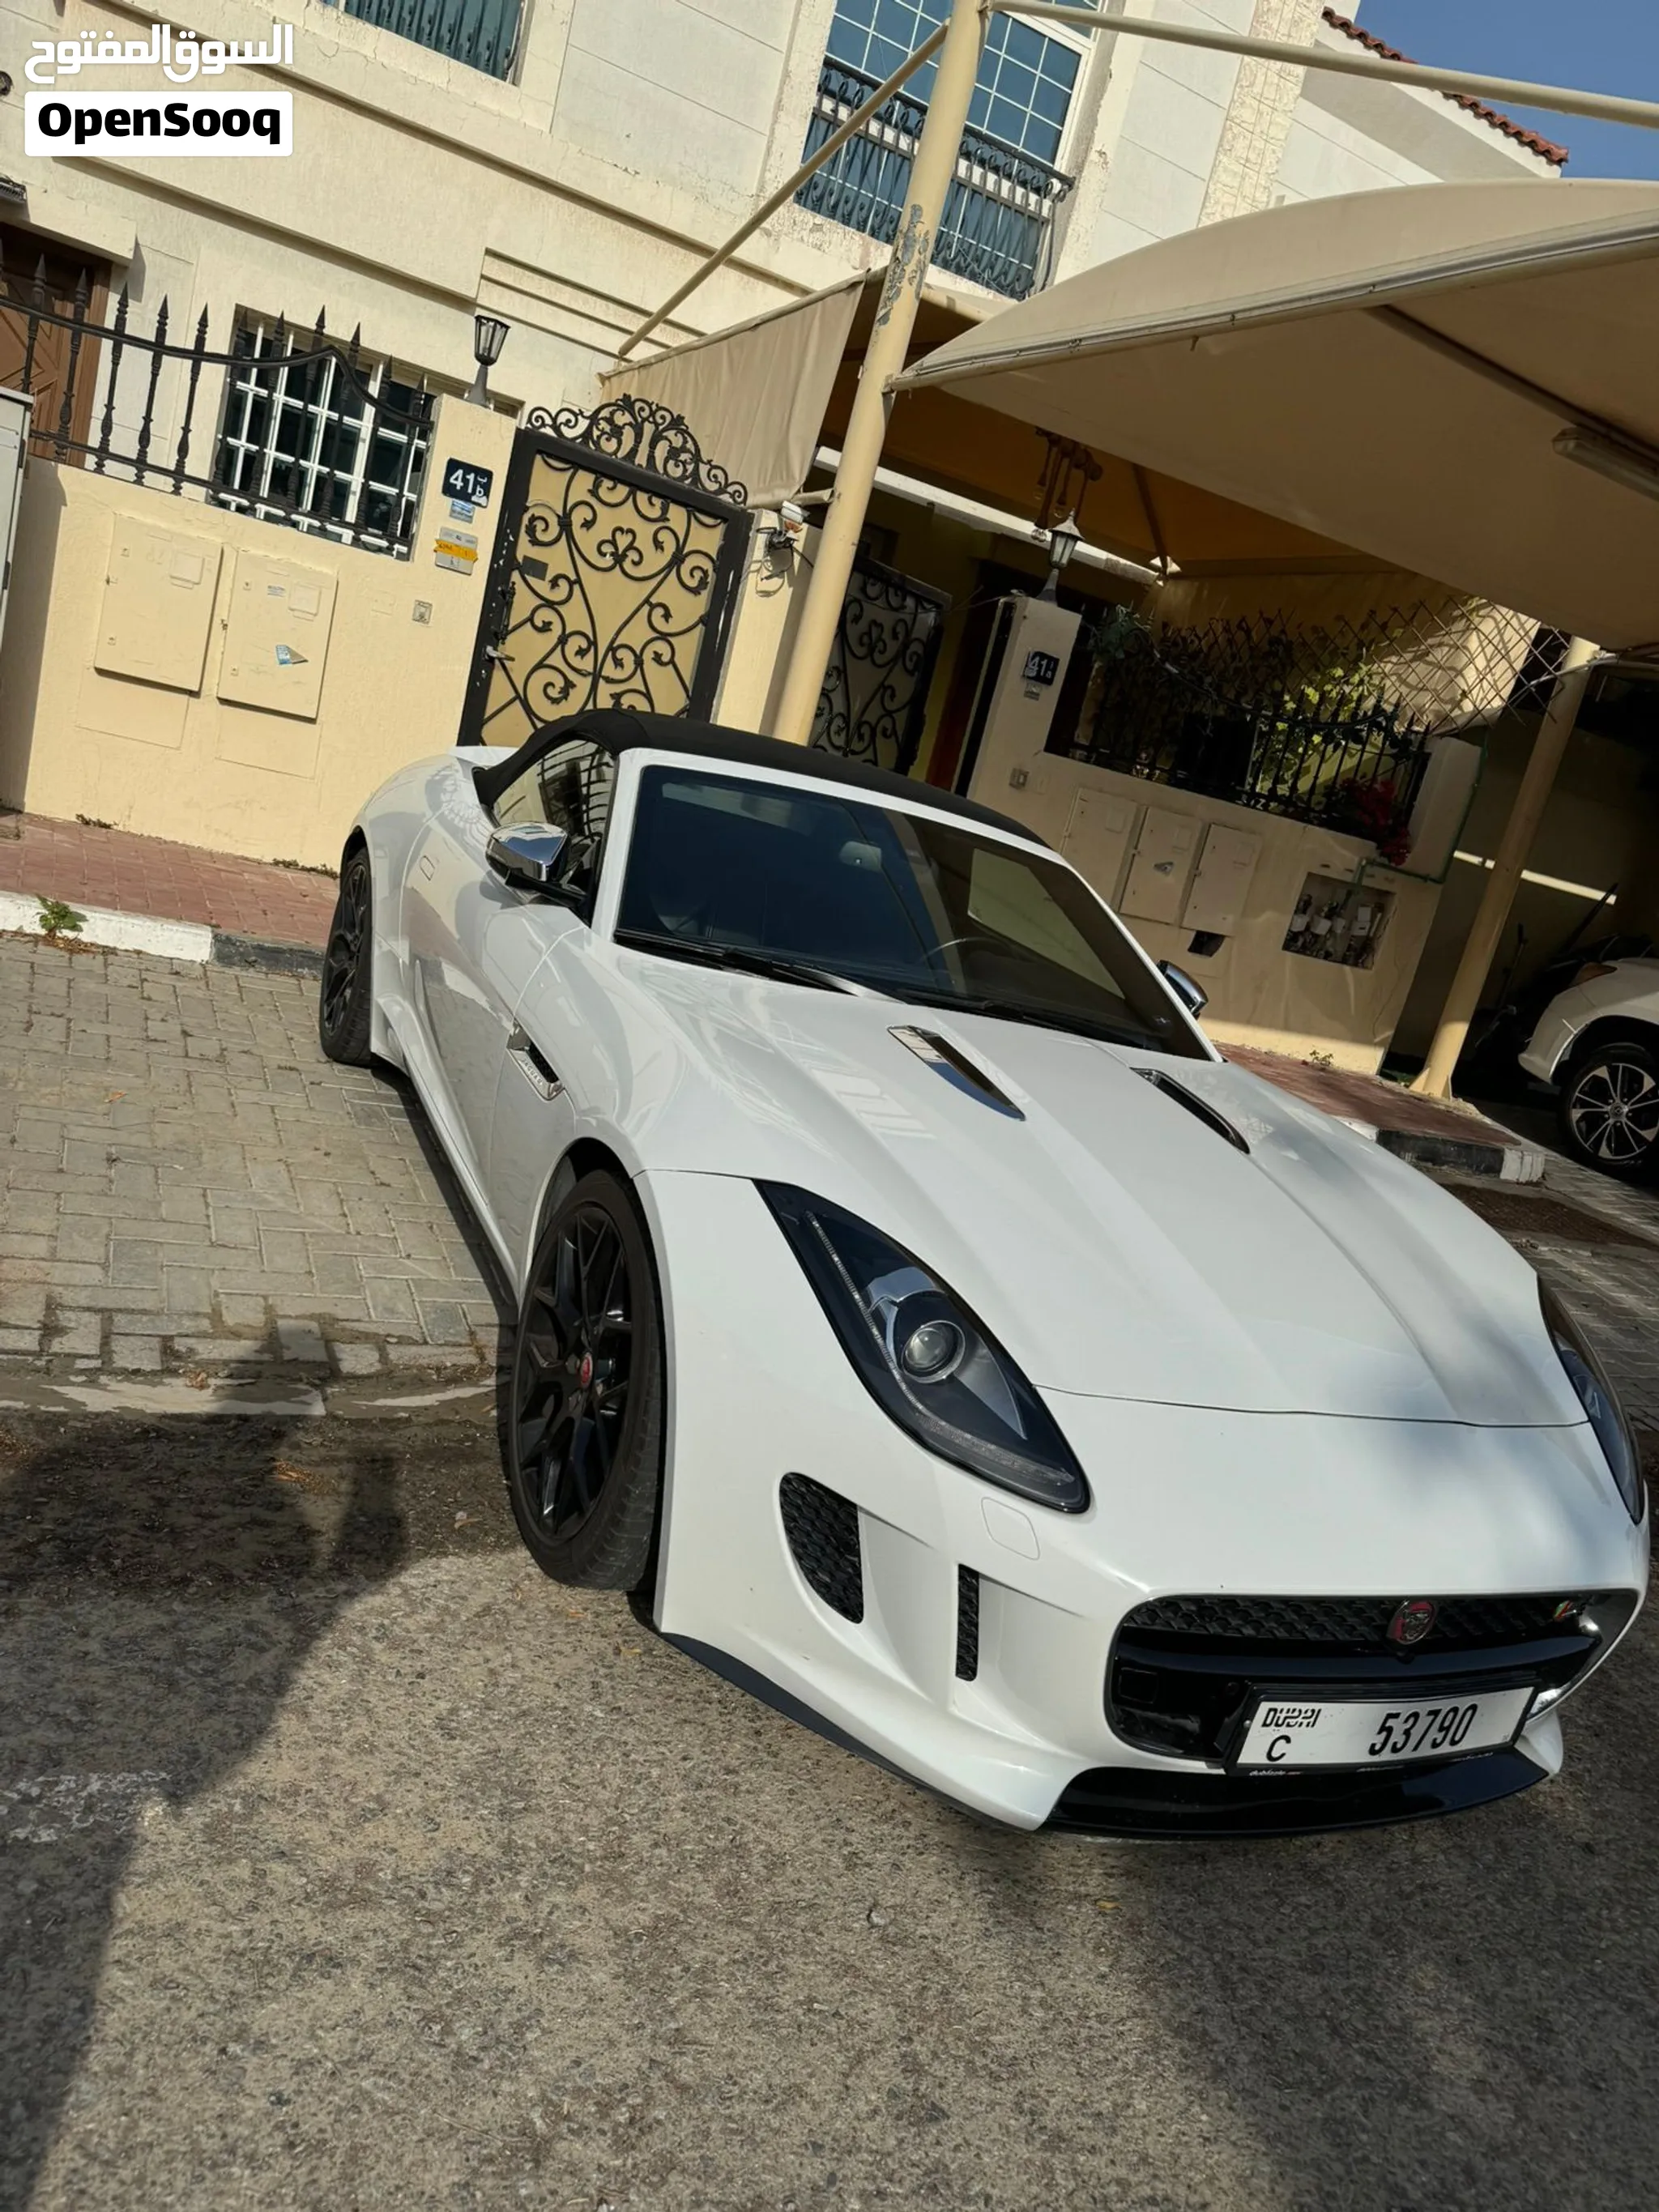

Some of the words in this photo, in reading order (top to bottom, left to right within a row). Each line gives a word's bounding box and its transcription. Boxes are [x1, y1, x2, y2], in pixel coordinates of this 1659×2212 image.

[1261, 1707, 1322, 1728] DUBAI
[1266, 1734, 1291, 1762] C
[1368, 1703, 1478, 1757] 53790
